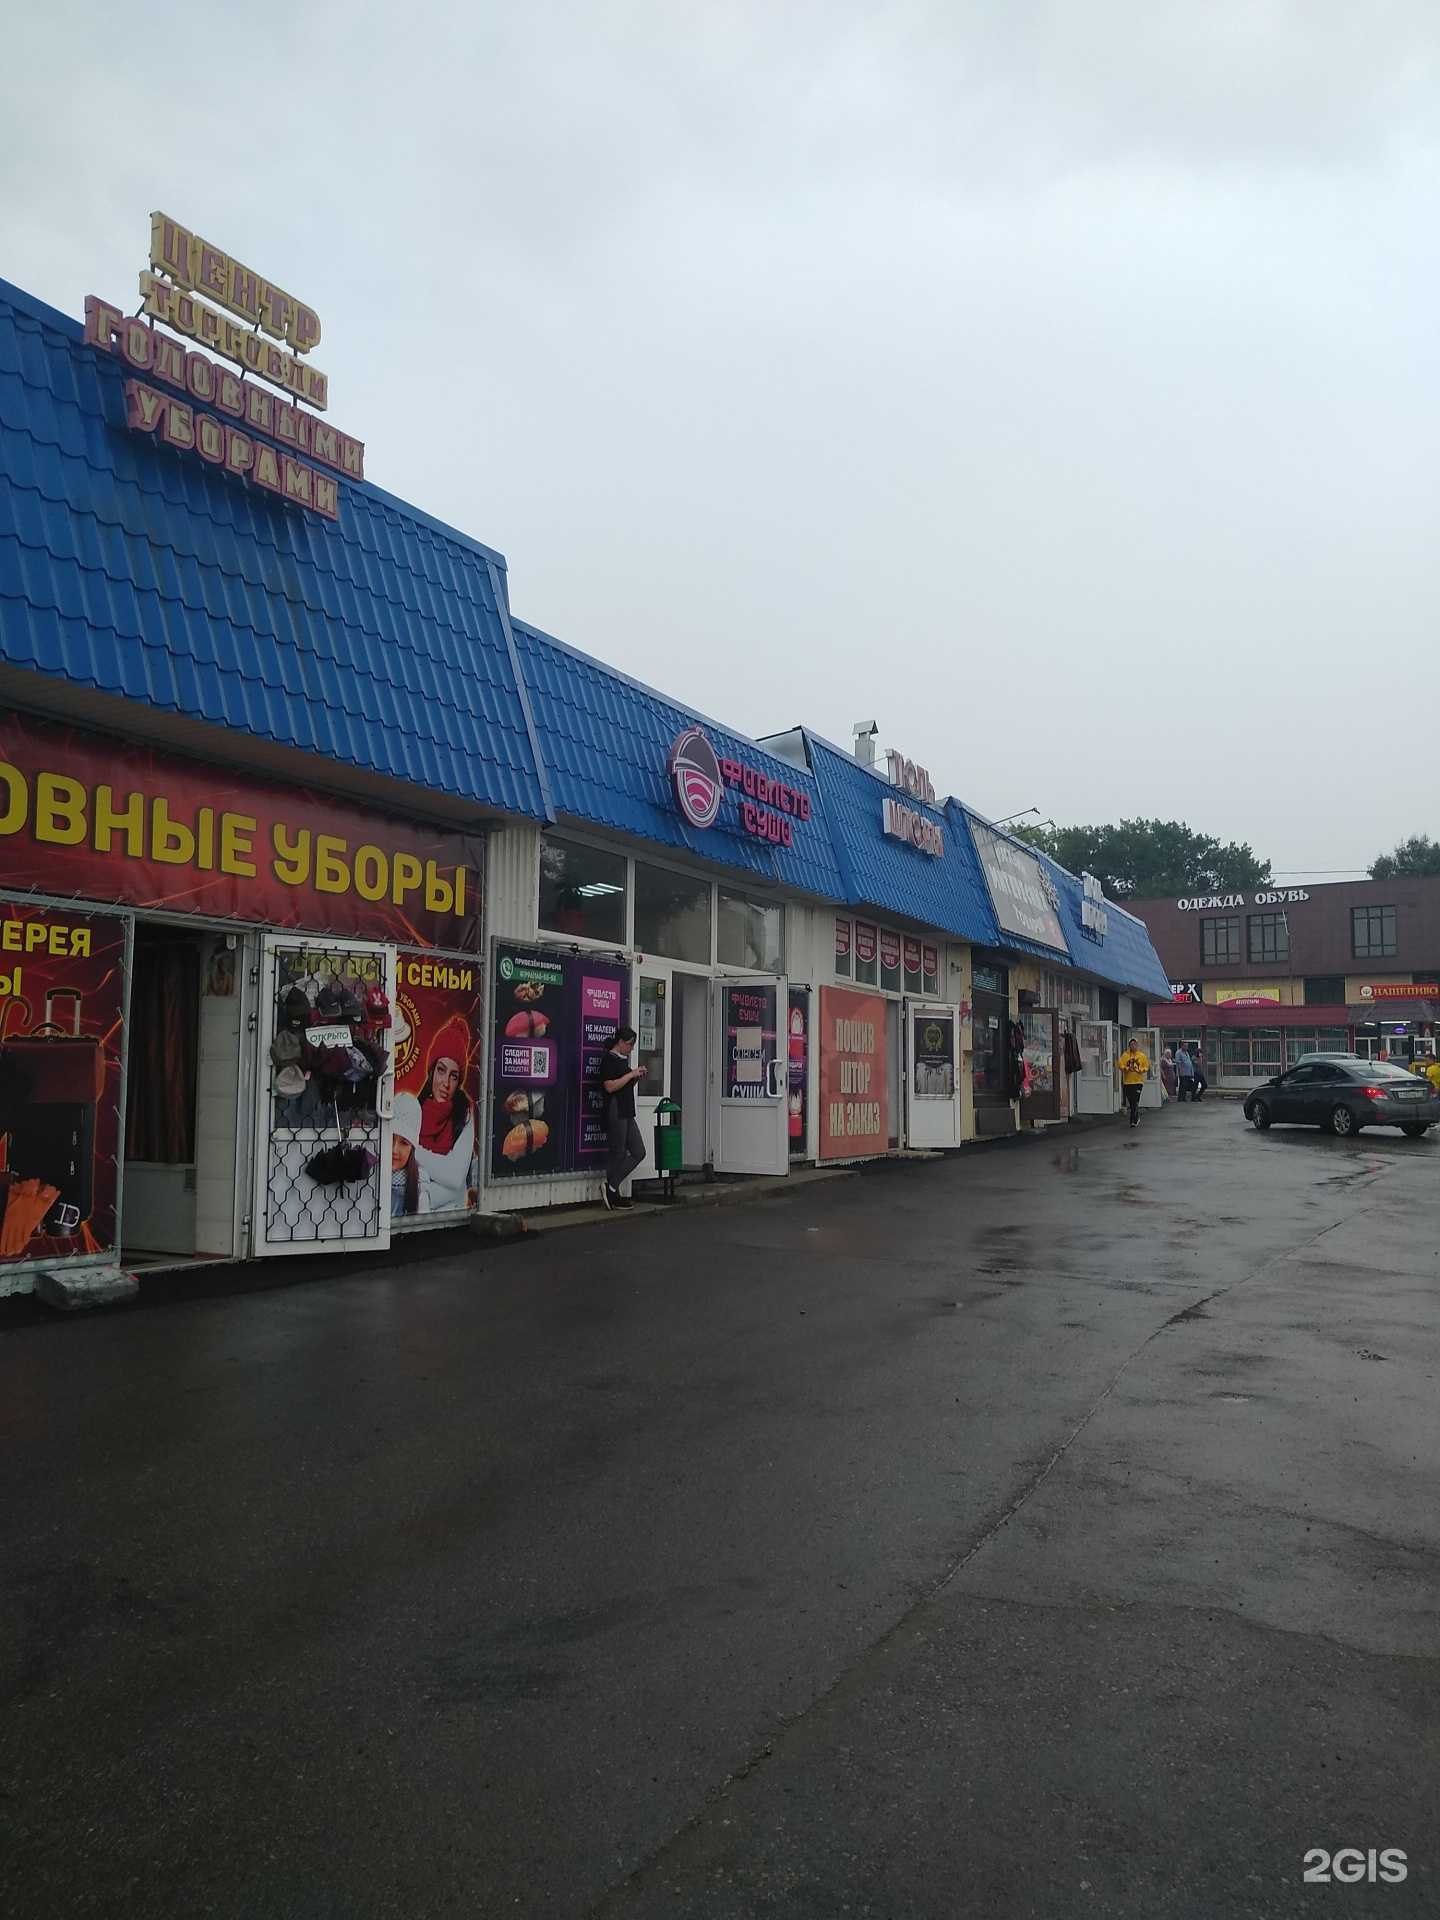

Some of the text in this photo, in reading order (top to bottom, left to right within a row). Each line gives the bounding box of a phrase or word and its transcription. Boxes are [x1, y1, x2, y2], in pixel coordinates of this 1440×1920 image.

[150, 210, 321, 354] ЦЕНТР
[139, 270, 328, 412] ТОРГОВЛИ
[84, 294, 365, 482] ГОЛОВНЫМИ
[126, 378, 338, 522] УБОРАМИ
[272, 822, 467, 917] УБОРЫ
[1177, 889, 1310, 912] ОДЕЖДА ОБУВЬ
[0, 919, 91, 958] ЕРЕЯ
[408, 963, 473, 991] СЕМЬИ
[310, 1032, 349, 1043] ОТКРЫТО
[504, 1048, 530, 1058] СЛЕДИТЕ
[836, 1018, 874, 1054] ПОШИВ
[504, 1056, 512, 1065] ЗА
[840, 1061, 871, 1094] ШТОР
[829, 1102, 880, 1137] НА ЗАКАЗ
